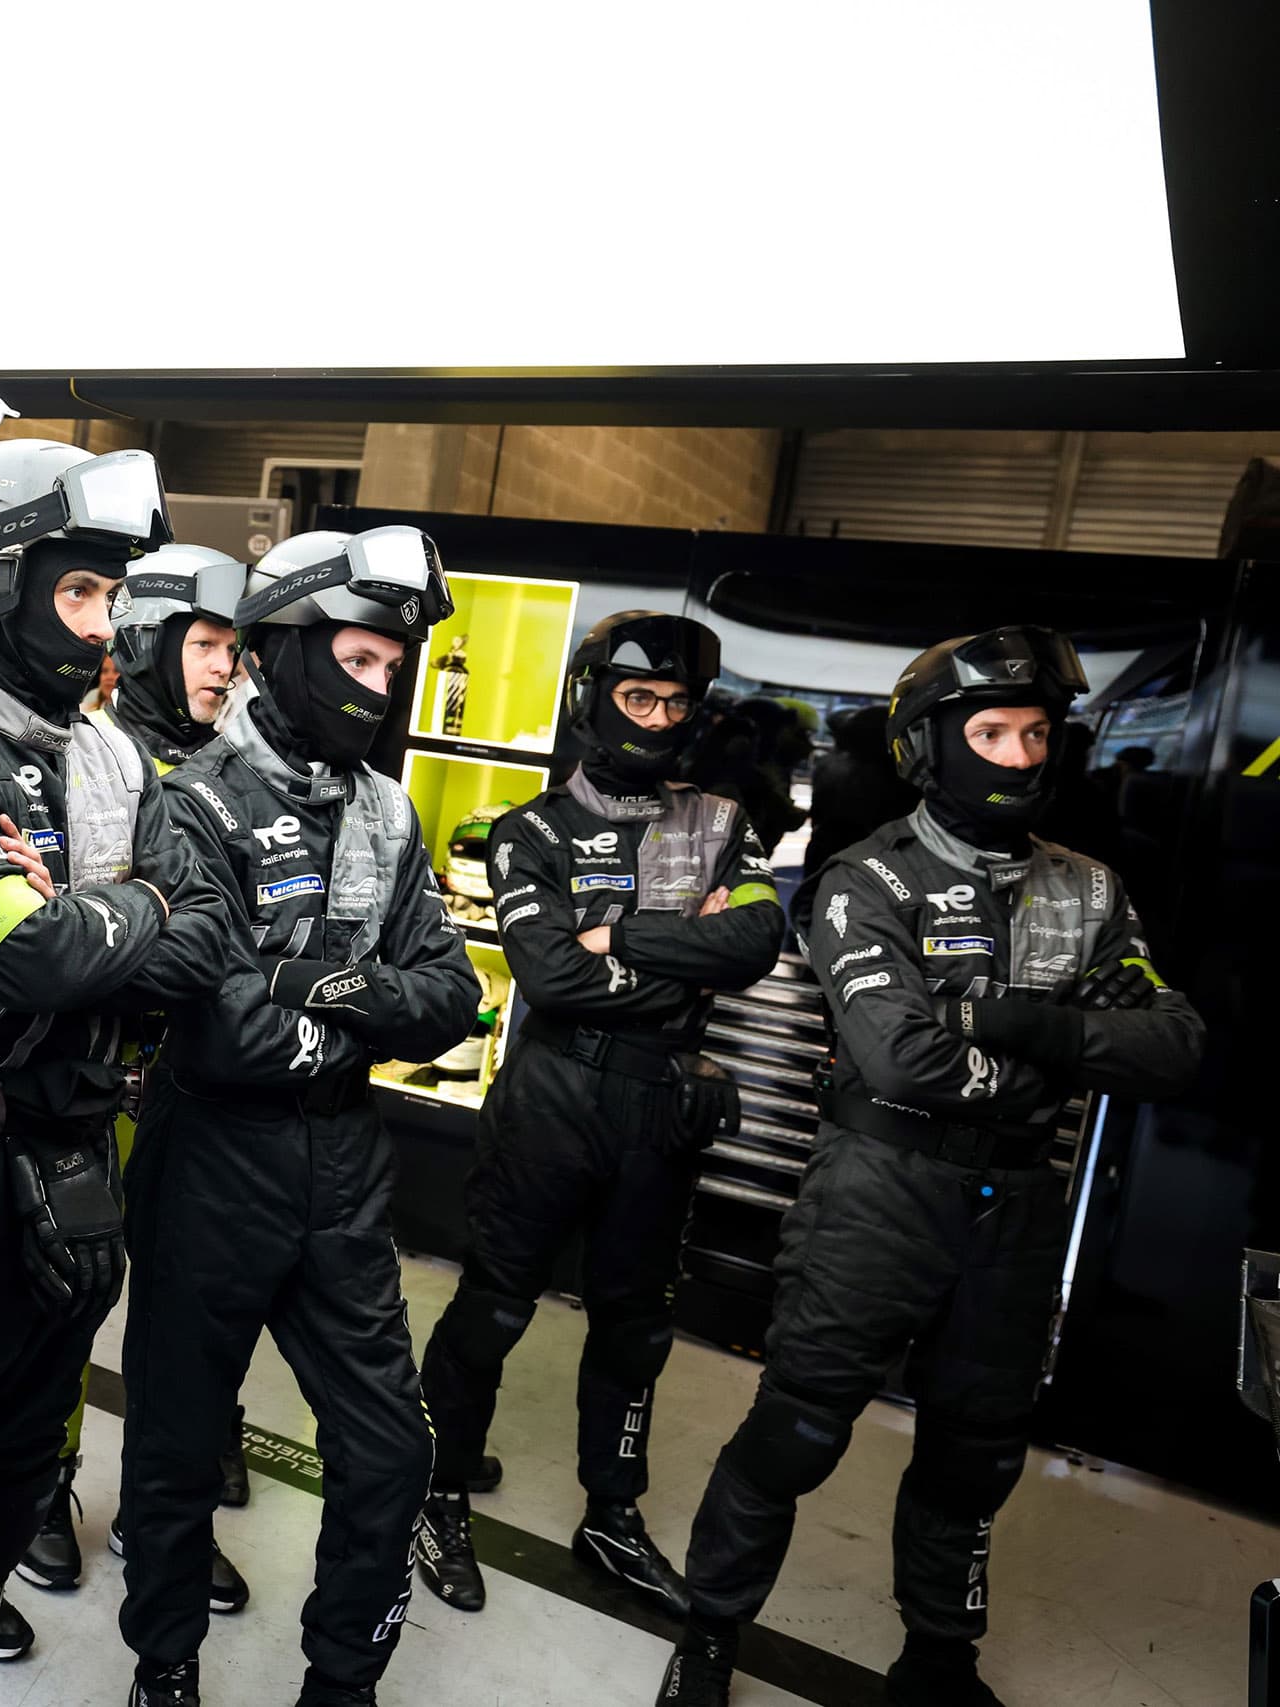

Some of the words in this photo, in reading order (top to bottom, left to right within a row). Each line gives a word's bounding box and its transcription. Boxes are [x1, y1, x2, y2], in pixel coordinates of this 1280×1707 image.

[191, 781, 238, 832] sparco
[863, 858, 911, 902] sparco
[322, 974, 368, 1002] sparco
